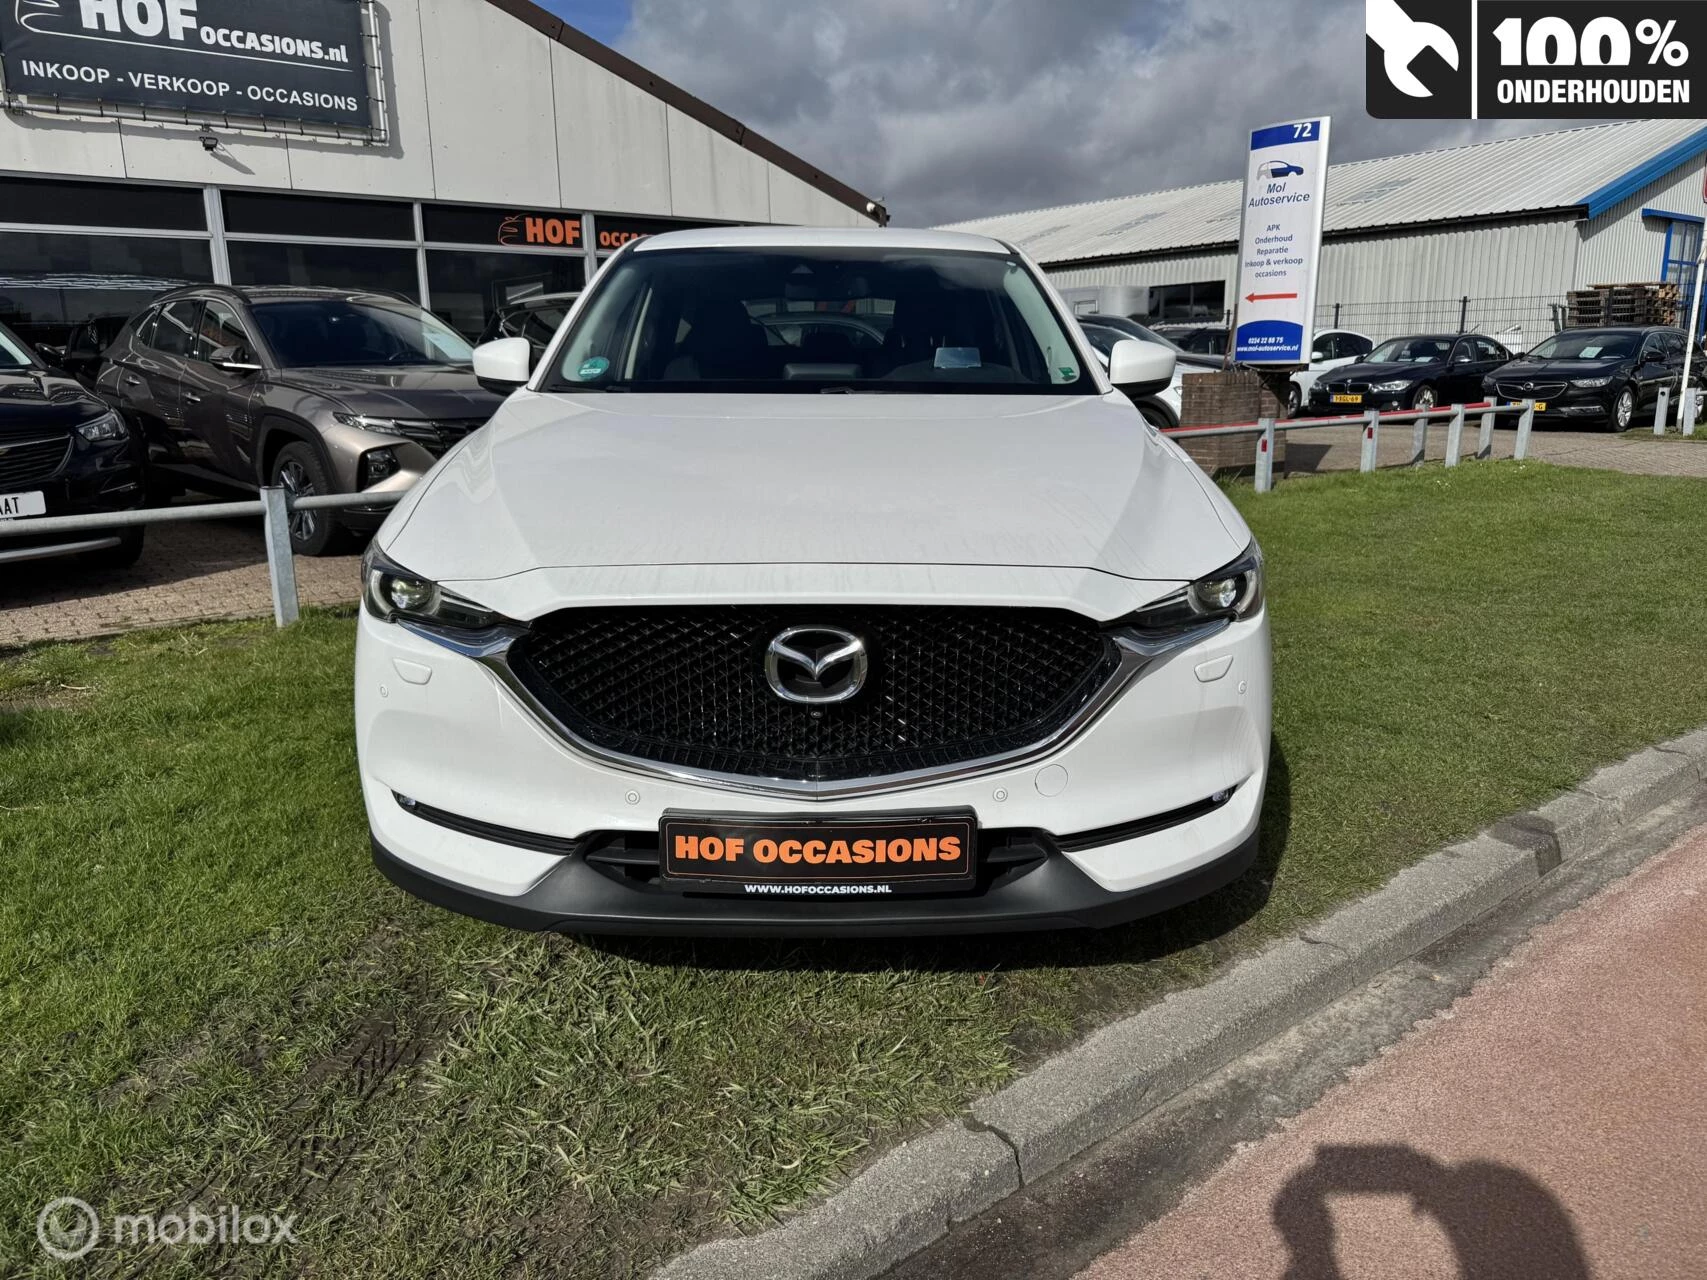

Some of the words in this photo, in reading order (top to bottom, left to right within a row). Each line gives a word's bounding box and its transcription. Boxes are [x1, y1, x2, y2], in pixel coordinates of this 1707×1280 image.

[80, 0, 197, 41] HOF
[200, 26, 348, 63] OCCASIONS.nl
[22, 60, 110, 83] INKOOP
[128, 72, 230, 97] VERKOOP
[247, 85, 358, 112] OCCASIONS
[1293, 123, 1312, 138] 72
[1266, 182, 1287, 194] Mol
[1248, 192, 1310, 208] Autoservice
[525, 217, 580, 245] HOF
[1255, 234, 1293, 244] Onderhoud
[1256, 246, 1289, 256] Reparatie
[1273, 257, 1303, 265] verkoop
[1255, 270, 1287, 278] occasions
[675, 835, 744, 862] HOF
[753, 836, 961, 864] OCCASIONS
[744, 884, 892, 894] WWW.HOFOCCASIONS.NL
